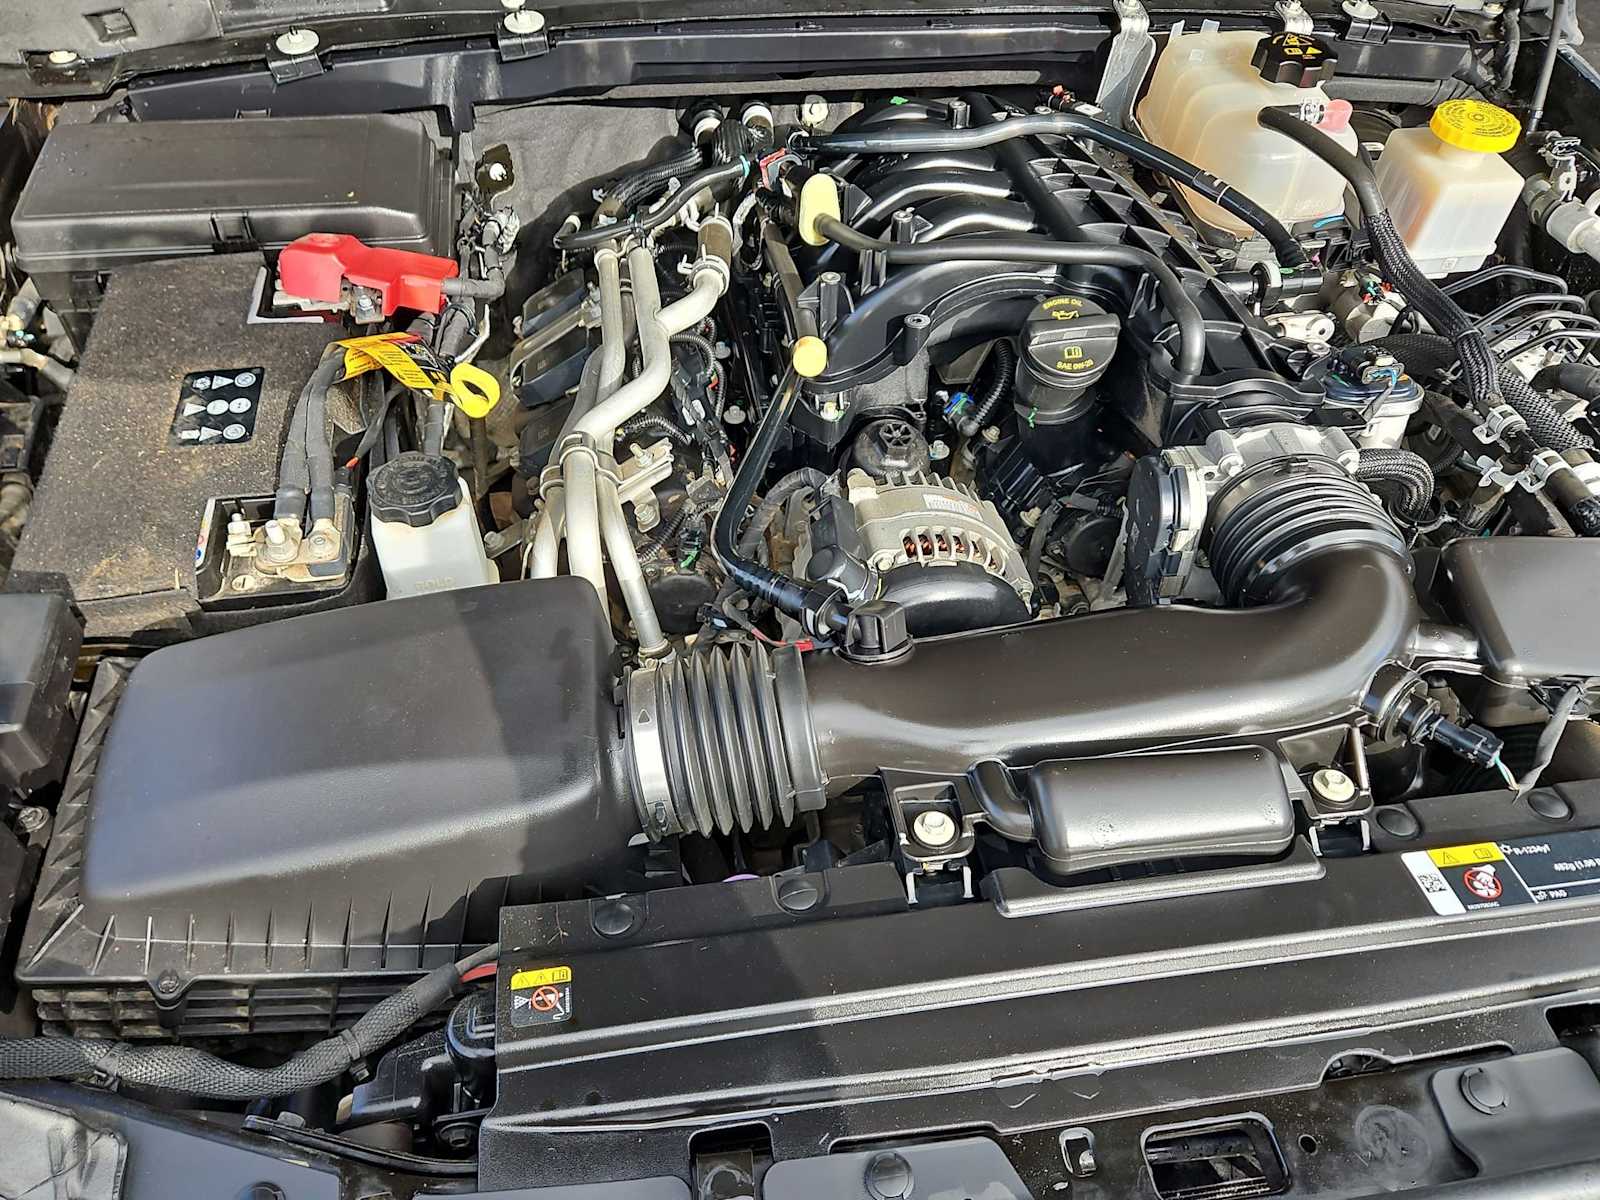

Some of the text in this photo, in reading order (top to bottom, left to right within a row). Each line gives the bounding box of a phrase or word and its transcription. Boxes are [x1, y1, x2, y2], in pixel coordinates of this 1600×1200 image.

[1043, 298, 1083, 309] ENGINE OIL
[1056, 361, 1073, 370] SAE
